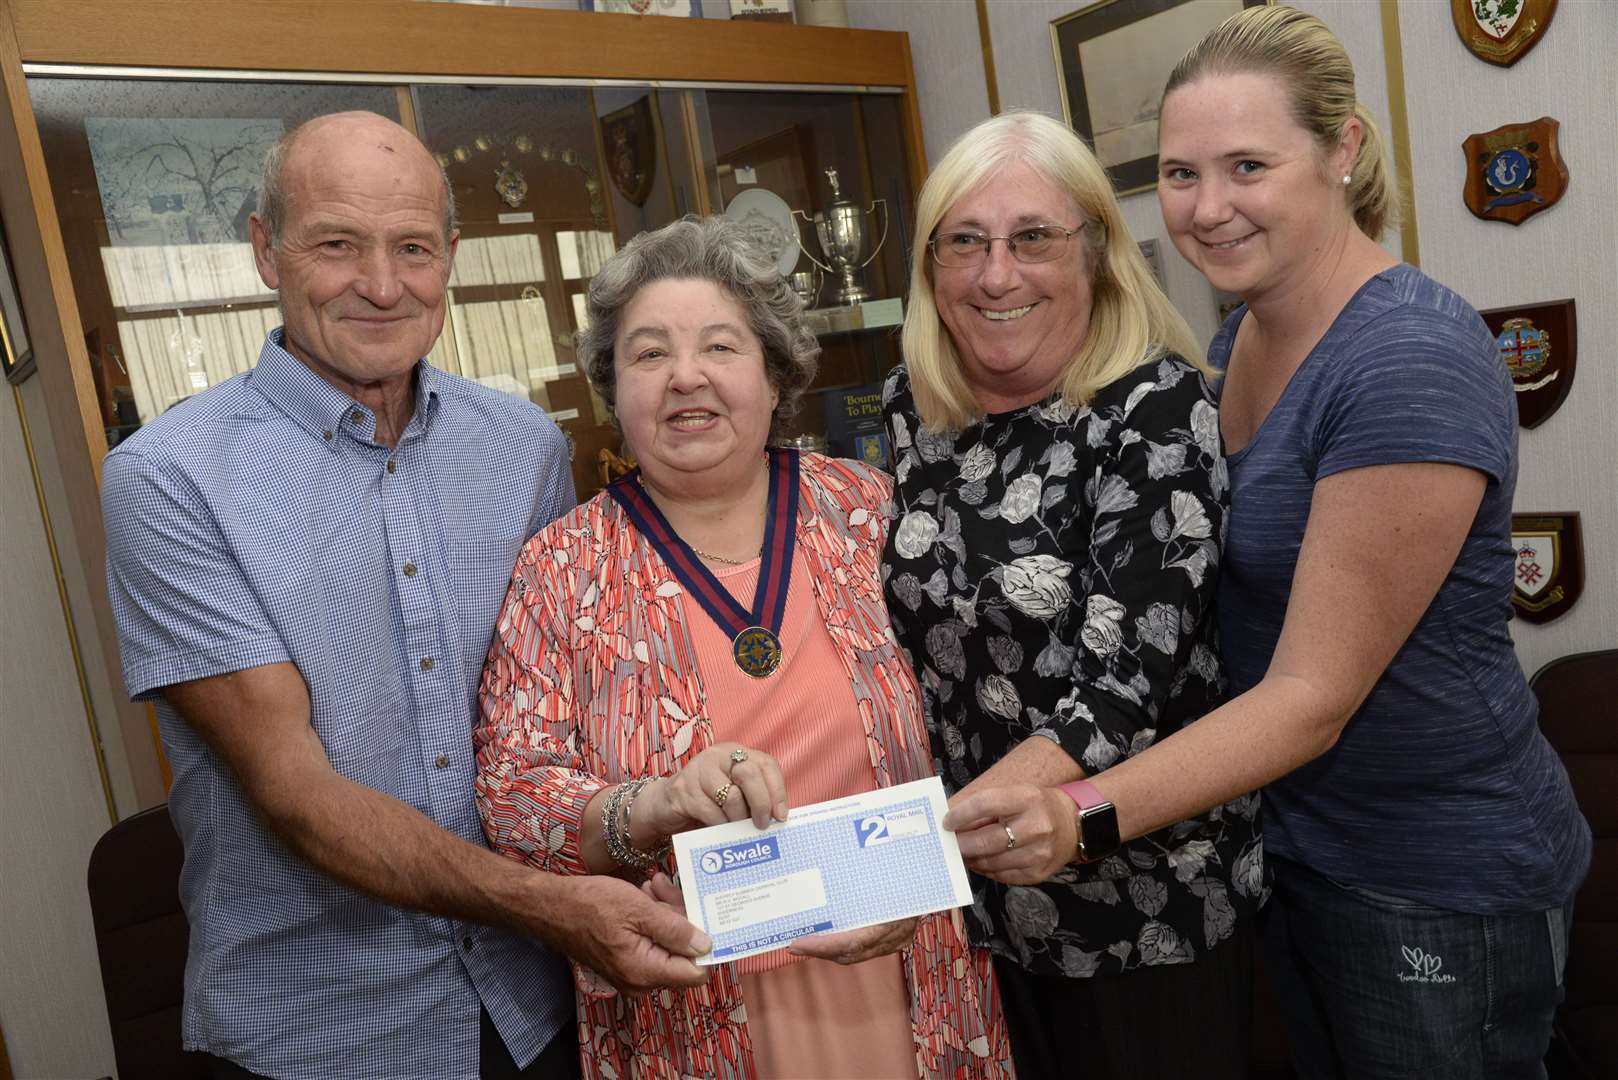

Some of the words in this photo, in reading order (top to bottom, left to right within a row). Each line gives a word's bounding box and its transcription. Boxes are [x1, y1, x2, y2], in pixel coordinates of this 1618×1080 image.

[846, 406, 859, 417] To
[886, 812, 907, 822] ROYAL
[908, 809, 924, 818] MAIL
[861, 816, 889, 847] 2
[722, 842, 772, 864] Swale
[732, 943, 748, 953] THIS
[748, 941, 757, 949] IS
[757, 937, 772, 948] NOT
[773, 934, 779, 942] A
[779, 926, 816, 941] CIRCULAR
